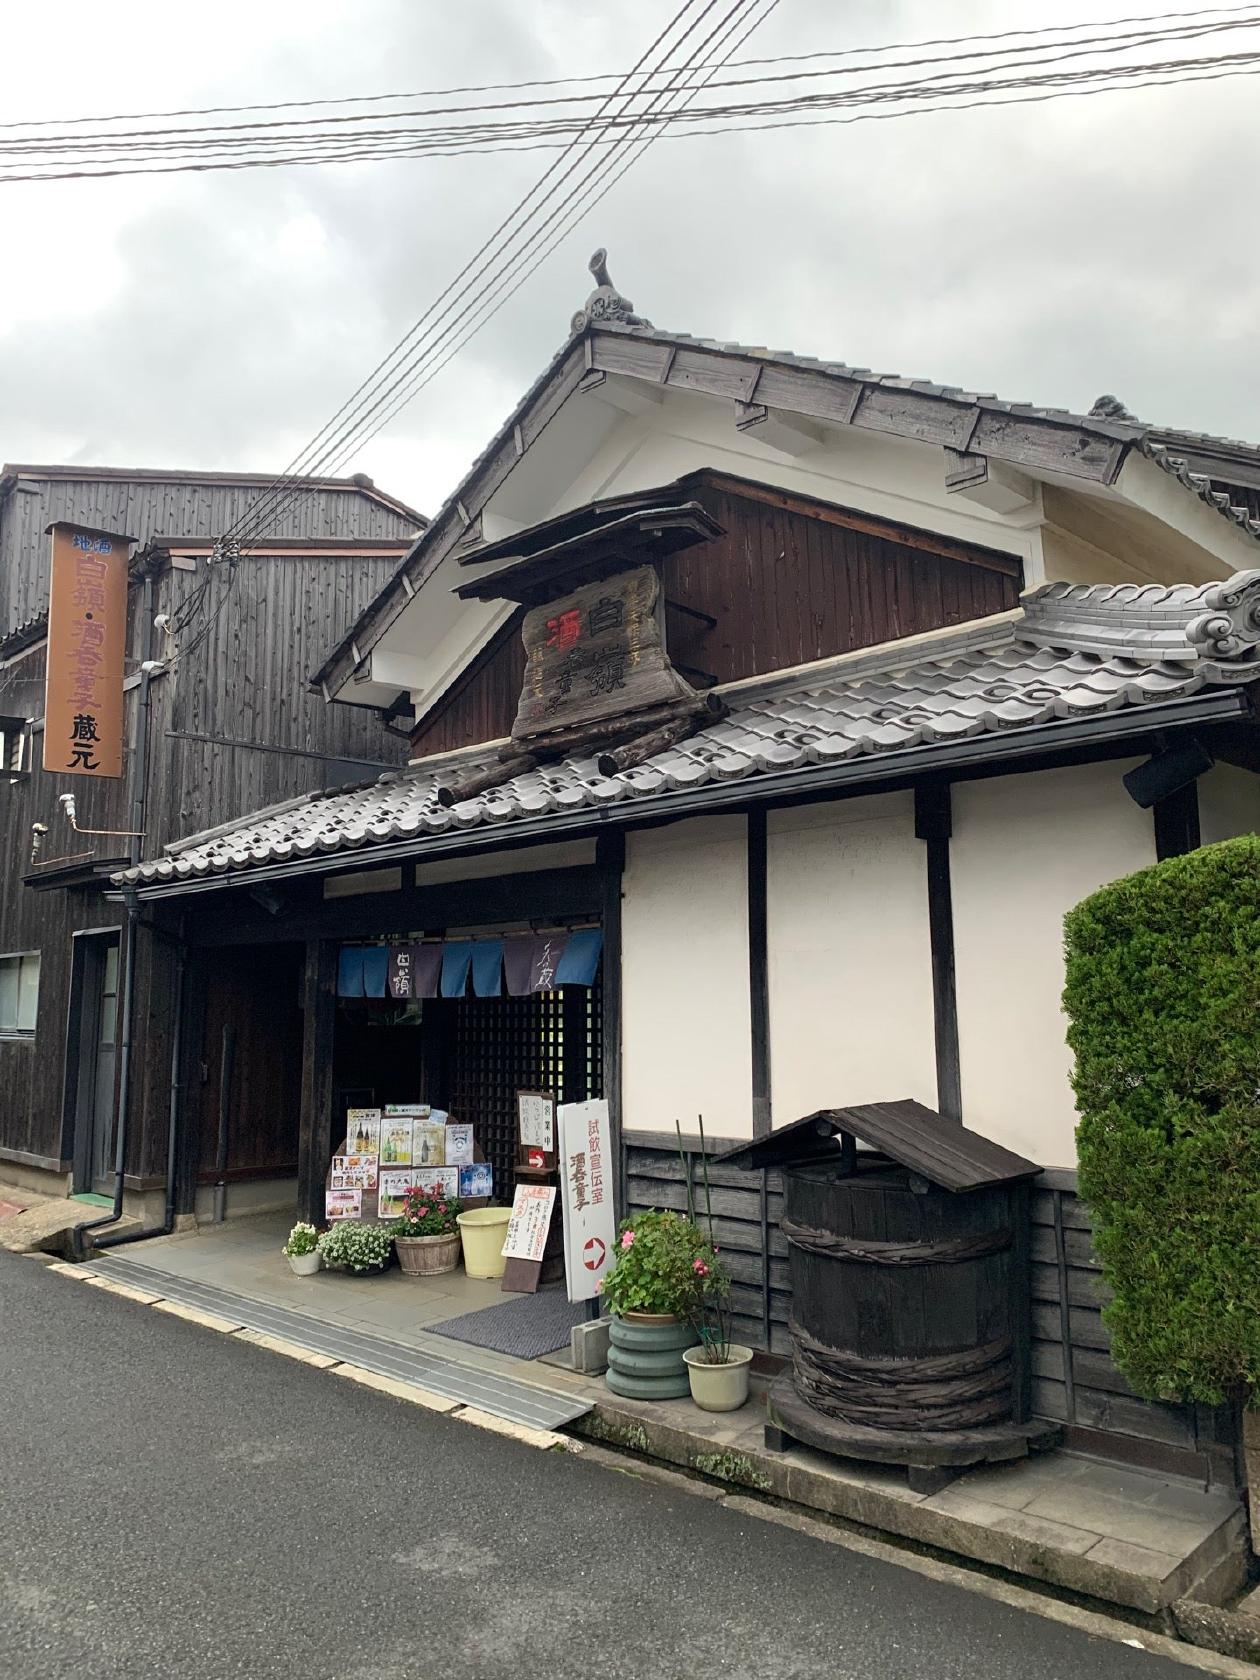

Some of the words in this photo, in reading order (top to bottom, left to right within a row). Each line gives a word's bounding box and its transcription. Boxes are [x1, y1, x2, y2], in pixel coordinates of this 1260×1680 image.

[72, 533, 113, 554] 地酒
[66, 713, 102, 770] 蔵元
[570, 1152, 590, 1211] 酒呑童子
[588, 1119, 604, 1205] 試飲宣伝室
